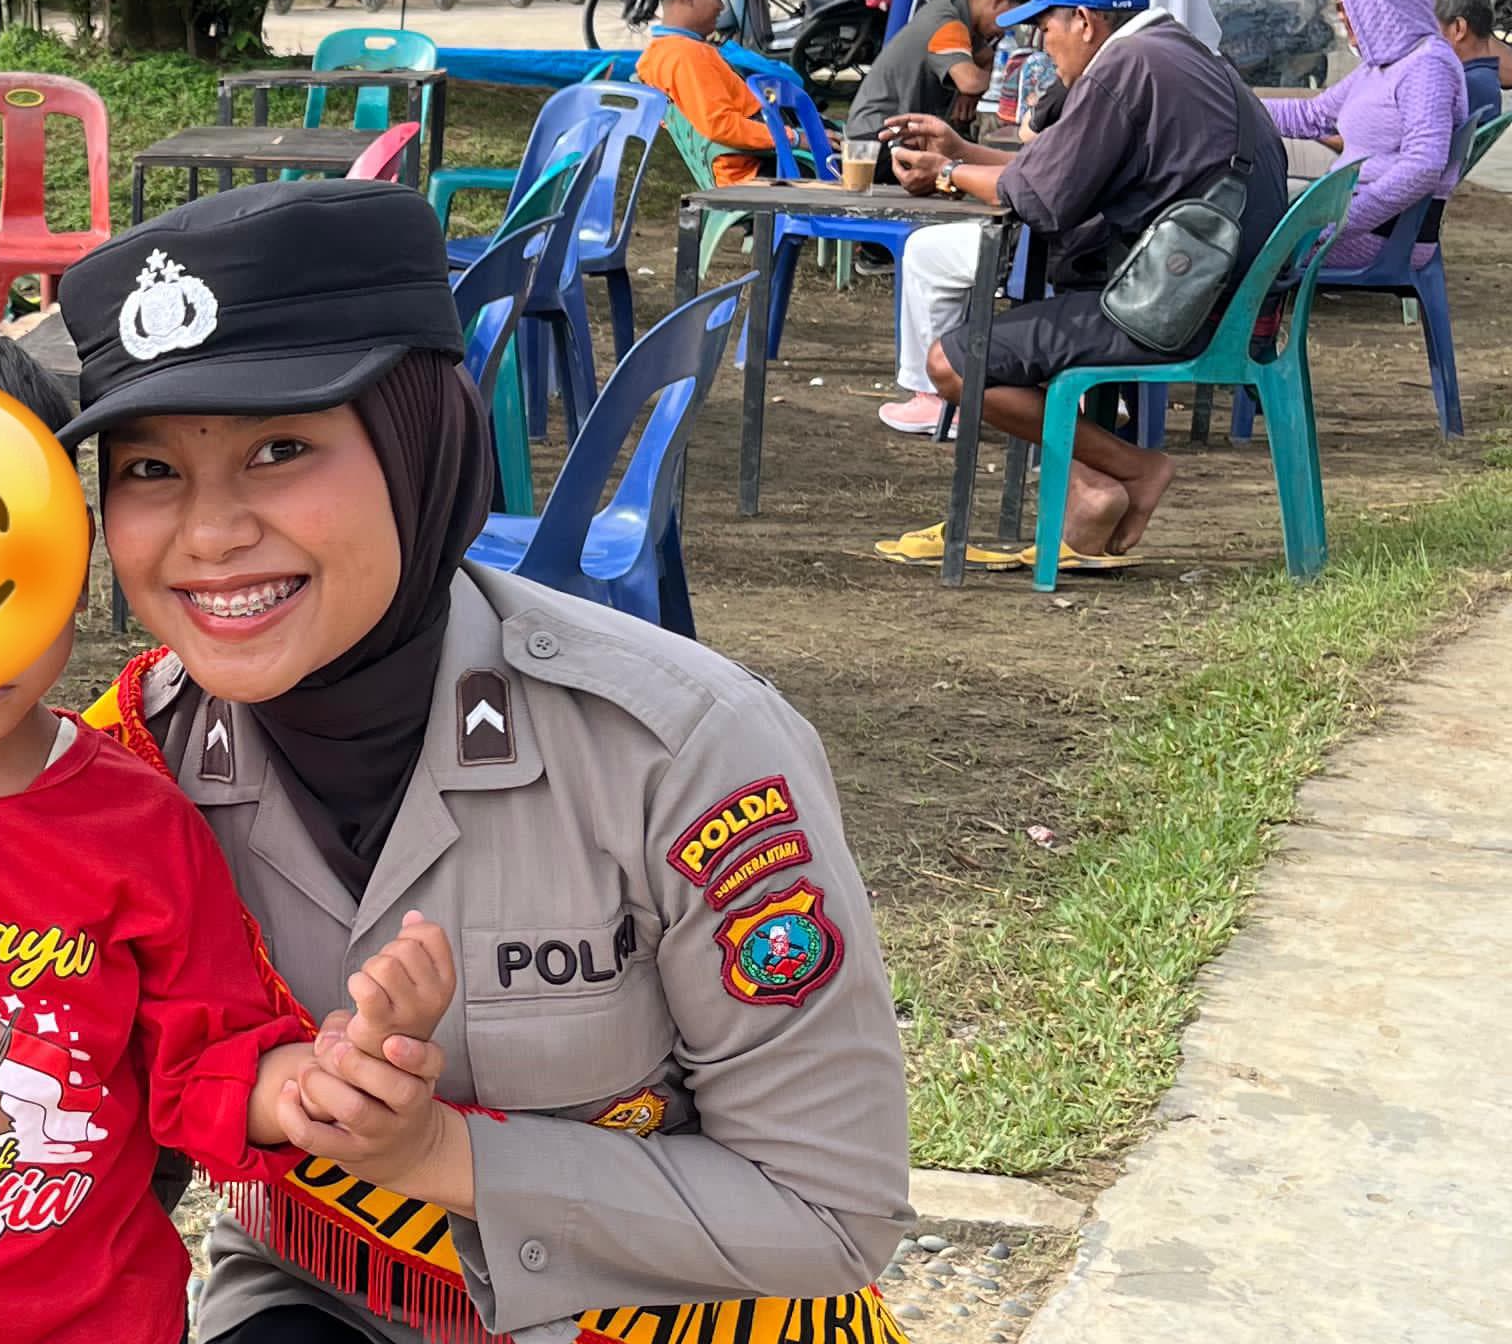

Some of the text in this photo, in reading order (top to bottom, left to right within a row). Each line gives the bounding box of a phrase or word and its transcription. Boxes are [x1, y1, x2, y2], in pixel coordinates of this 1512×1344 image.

[681, 787, 788, 873] POLDA
[714, 840, 800, 899] SUMATERA UTARA
